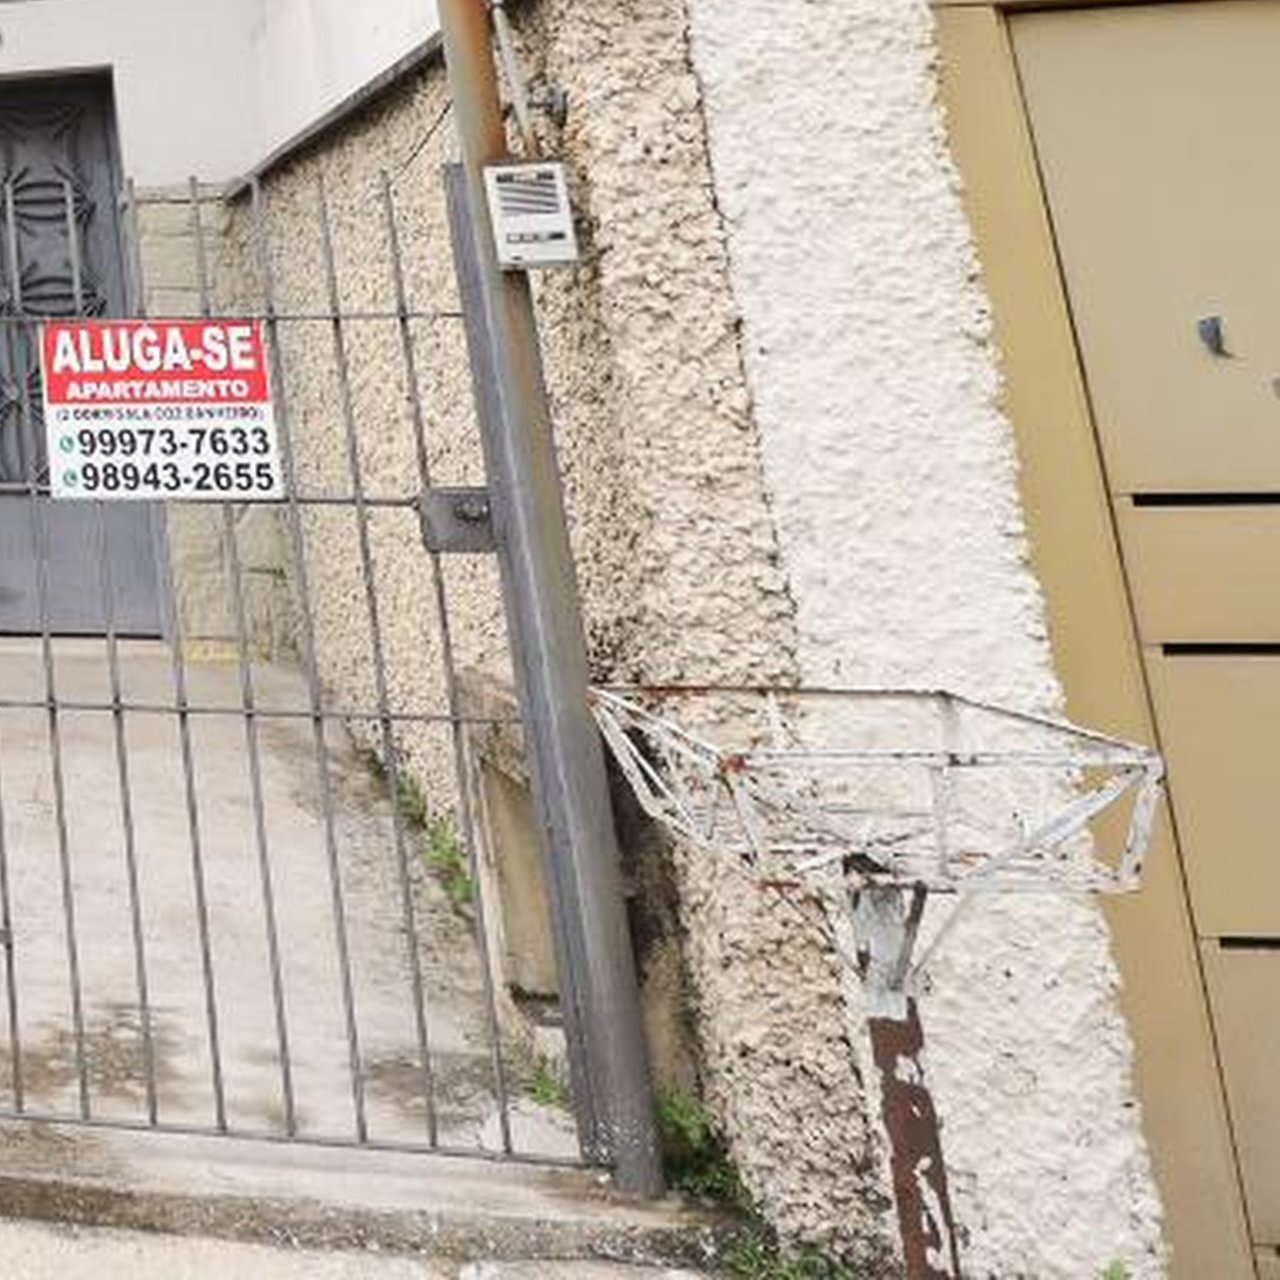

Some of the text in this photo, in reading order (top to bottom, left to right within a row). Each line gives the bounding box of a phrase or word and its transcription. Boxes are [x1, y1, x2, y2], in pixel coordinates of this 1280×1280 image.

[53, 325, 257, 373] ALUGA-SE
[67, 379, 249, 400] APARTAMENTO
[78, 428, 270, 457] 99973-7633
[82, 462, 275, 491] 98943-2655
